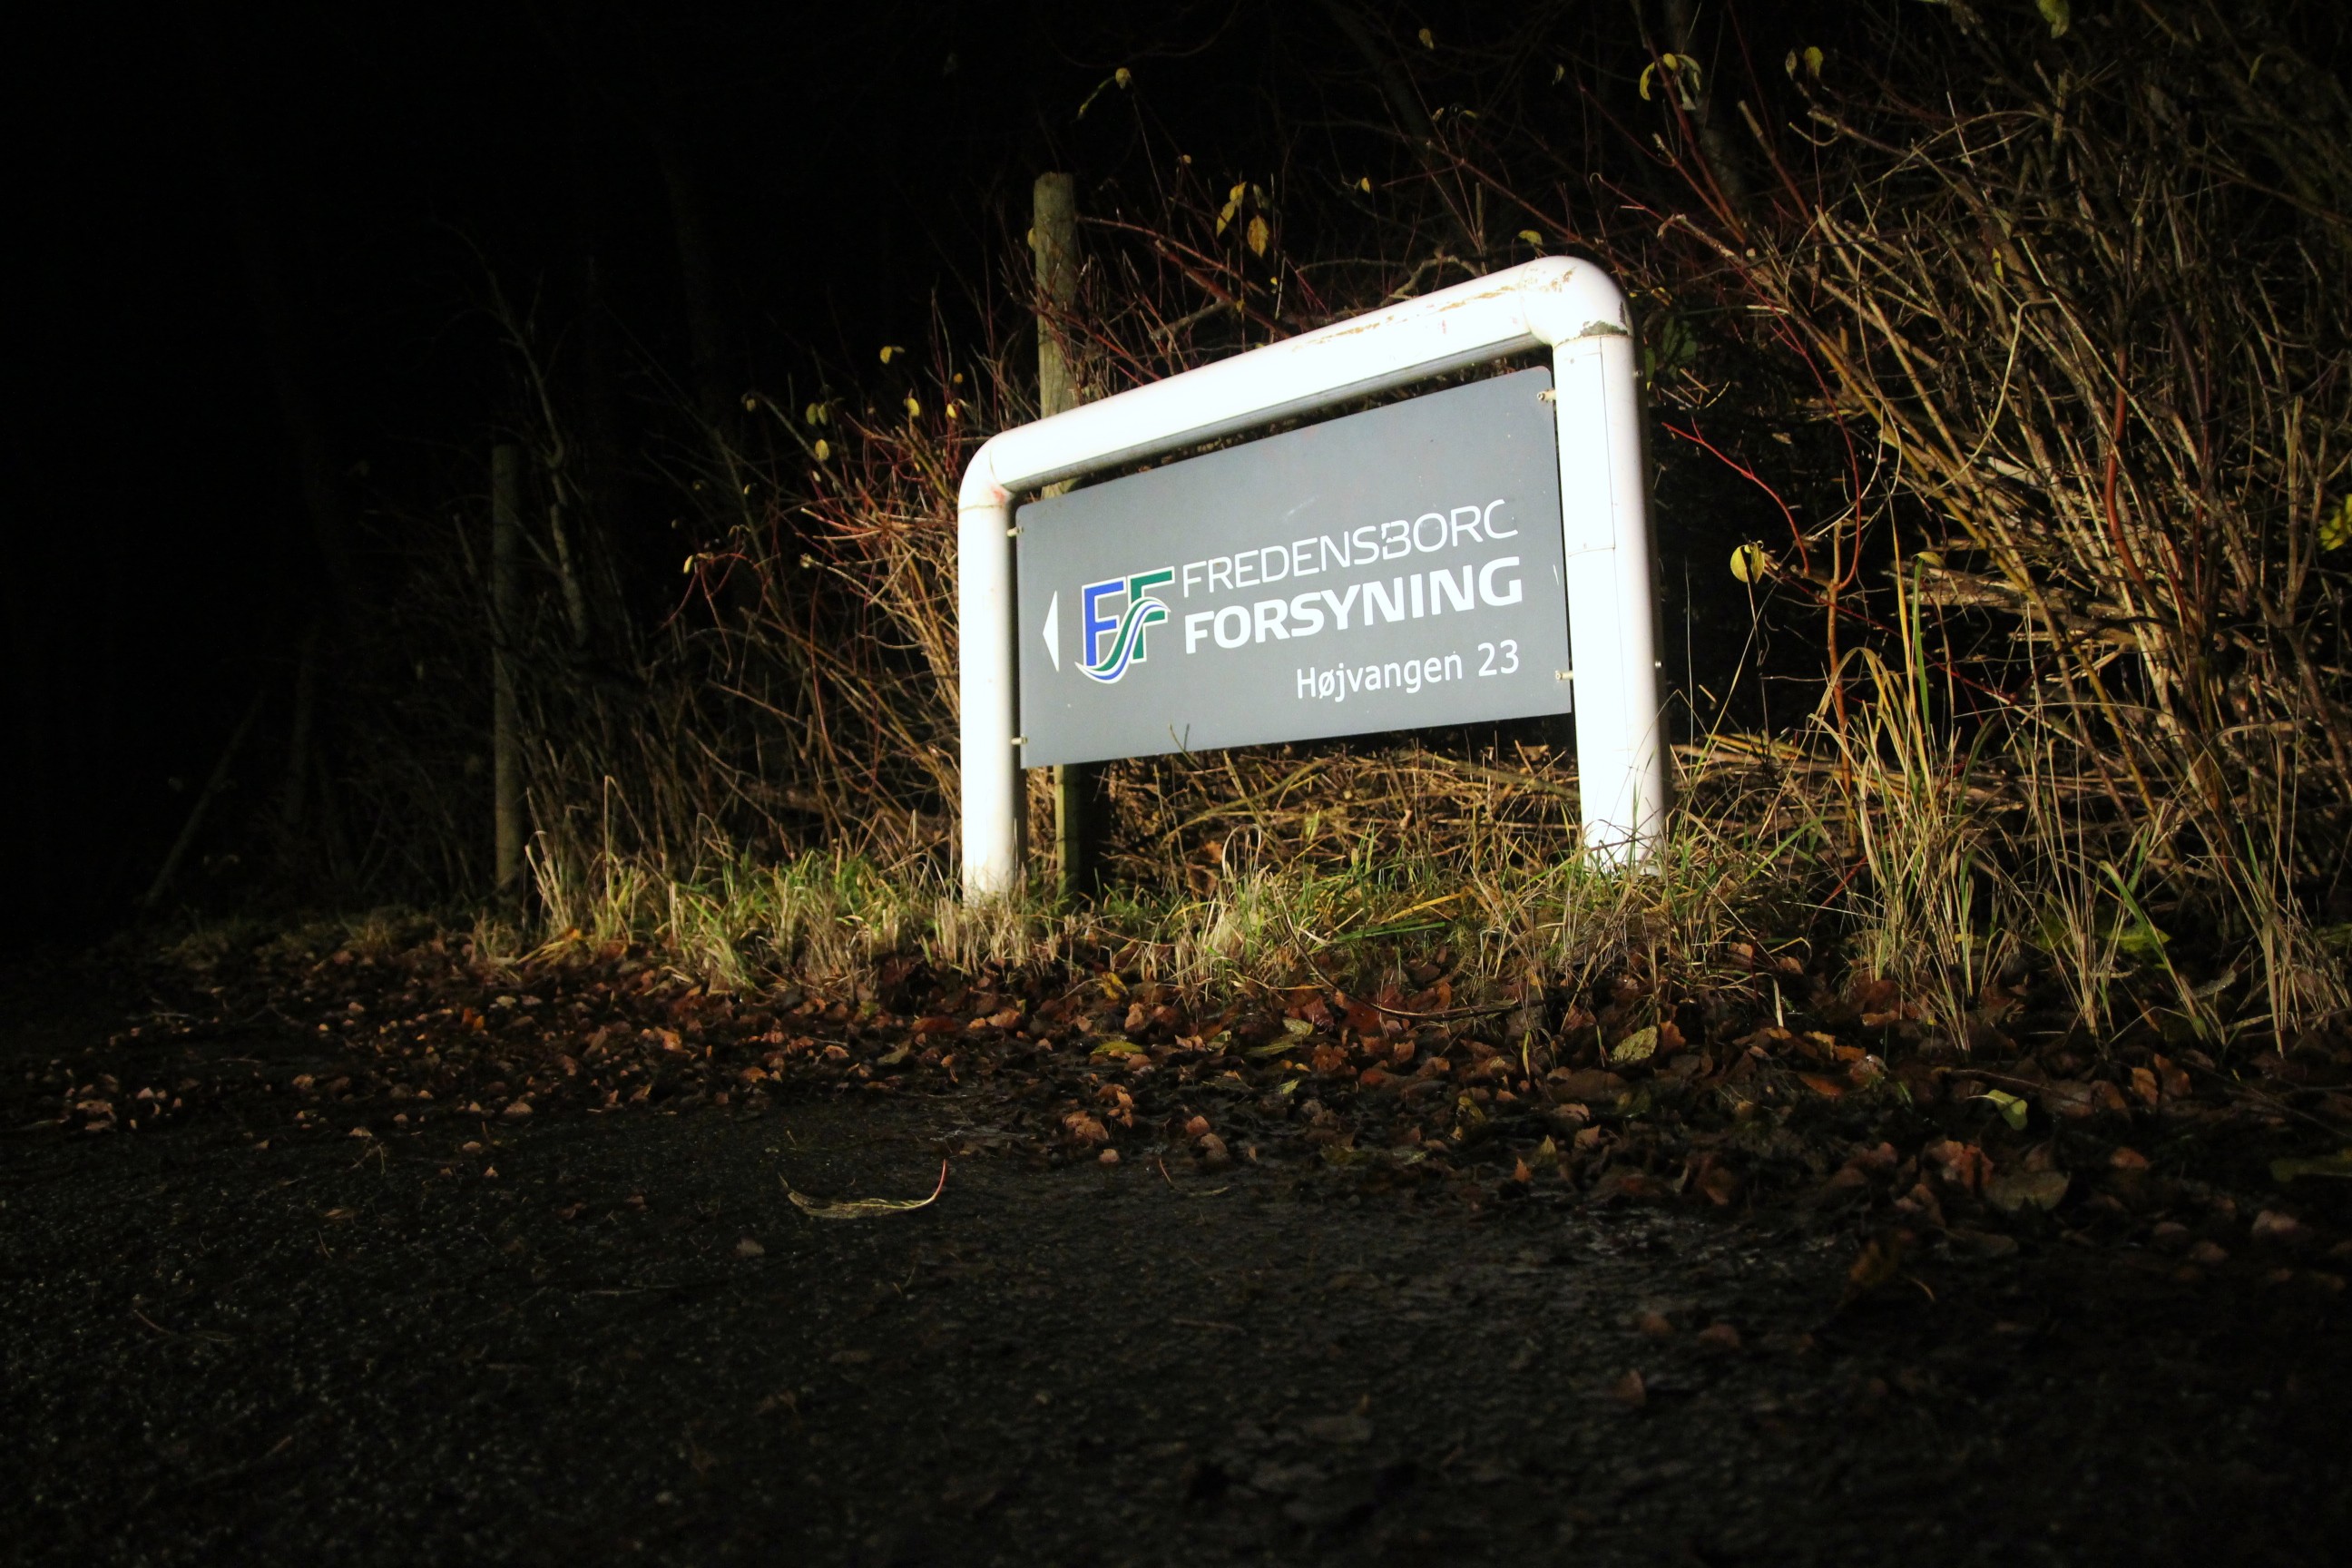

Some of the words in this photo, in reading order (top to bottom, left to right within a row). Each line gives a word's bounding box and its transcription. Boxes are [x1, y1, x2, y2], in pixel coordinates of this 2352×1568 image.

[1185, 555, 1523, 654] FORSYNING
[1297, 652, 1463, 702] Højvangen
[1477, 639, 1520, 678] 23
